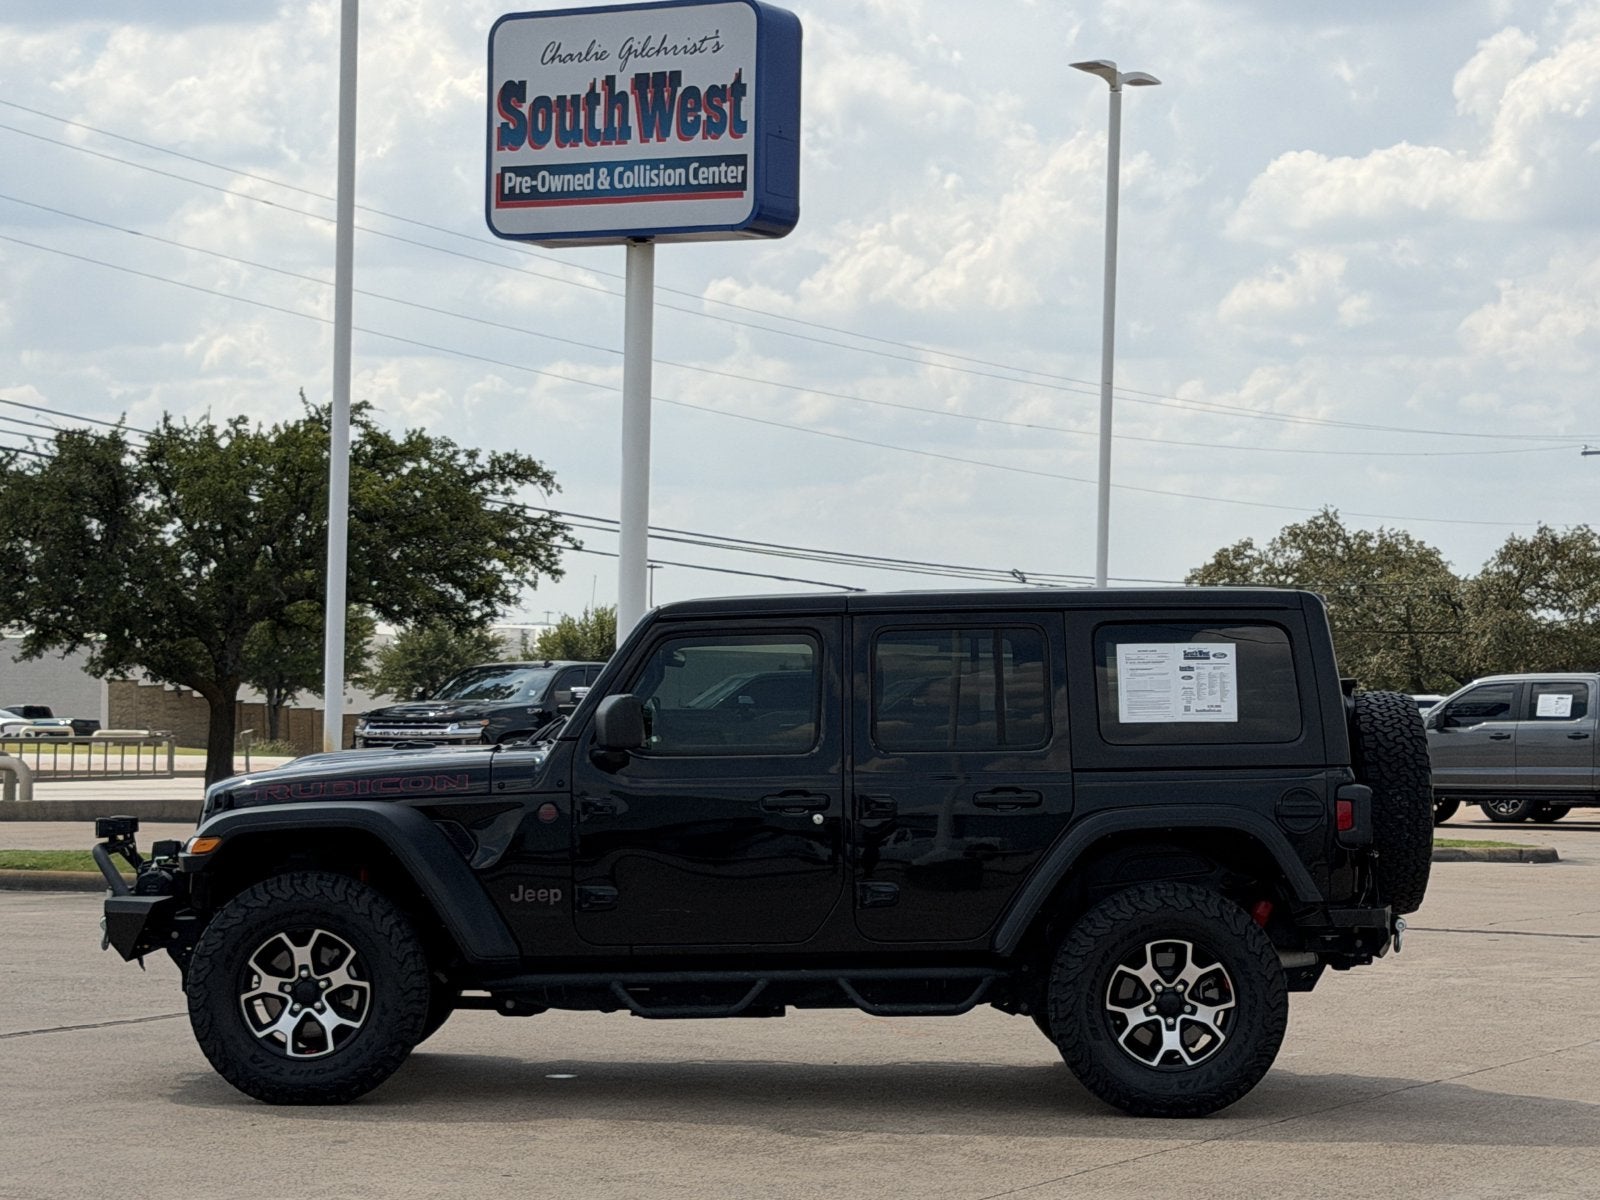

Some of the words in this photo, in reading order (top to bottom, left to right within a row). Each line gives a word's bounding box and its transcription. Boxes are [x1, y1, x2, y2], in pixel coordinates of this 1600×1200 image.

[540, 39, 610, 66] Charlie
[617, 29, 725, 72] Gilchrist's
[503, 167, 594, 195] Pre-Owned
[596, 166, 611, 190] &
[613, 162, 685, 189] Collision
[688, 162, 745, 185] Center
[255, 774, 469, 800] RUBICON
[510, 884, 562, 905] Jeep
